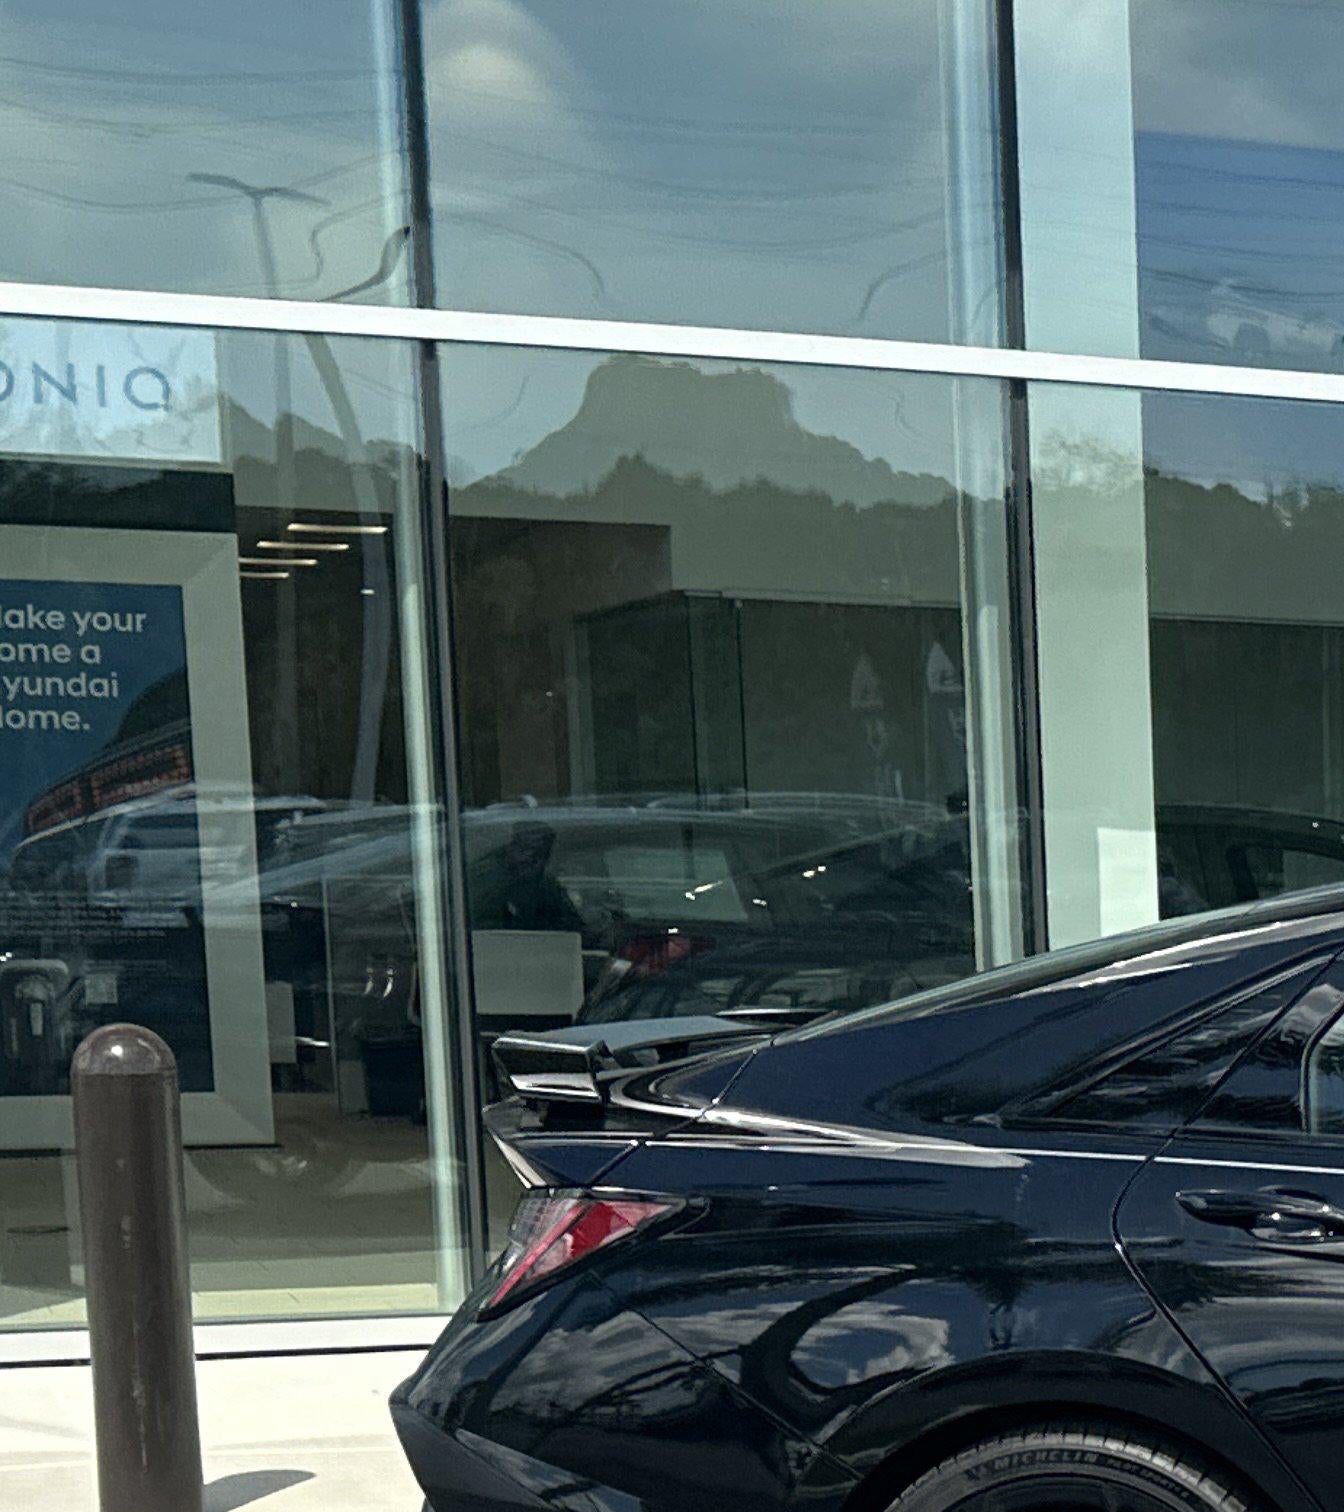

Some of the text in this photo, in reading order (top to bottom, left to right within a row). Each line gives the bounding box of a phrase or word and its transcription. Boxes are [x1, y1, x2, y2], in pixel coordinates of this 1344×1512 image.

[0, 604, 147, 636] ake your
[0, 642, 101, 665] ome a
[2, 671, 119, 701] yundai
[0, 705, 90, 731] ome.
